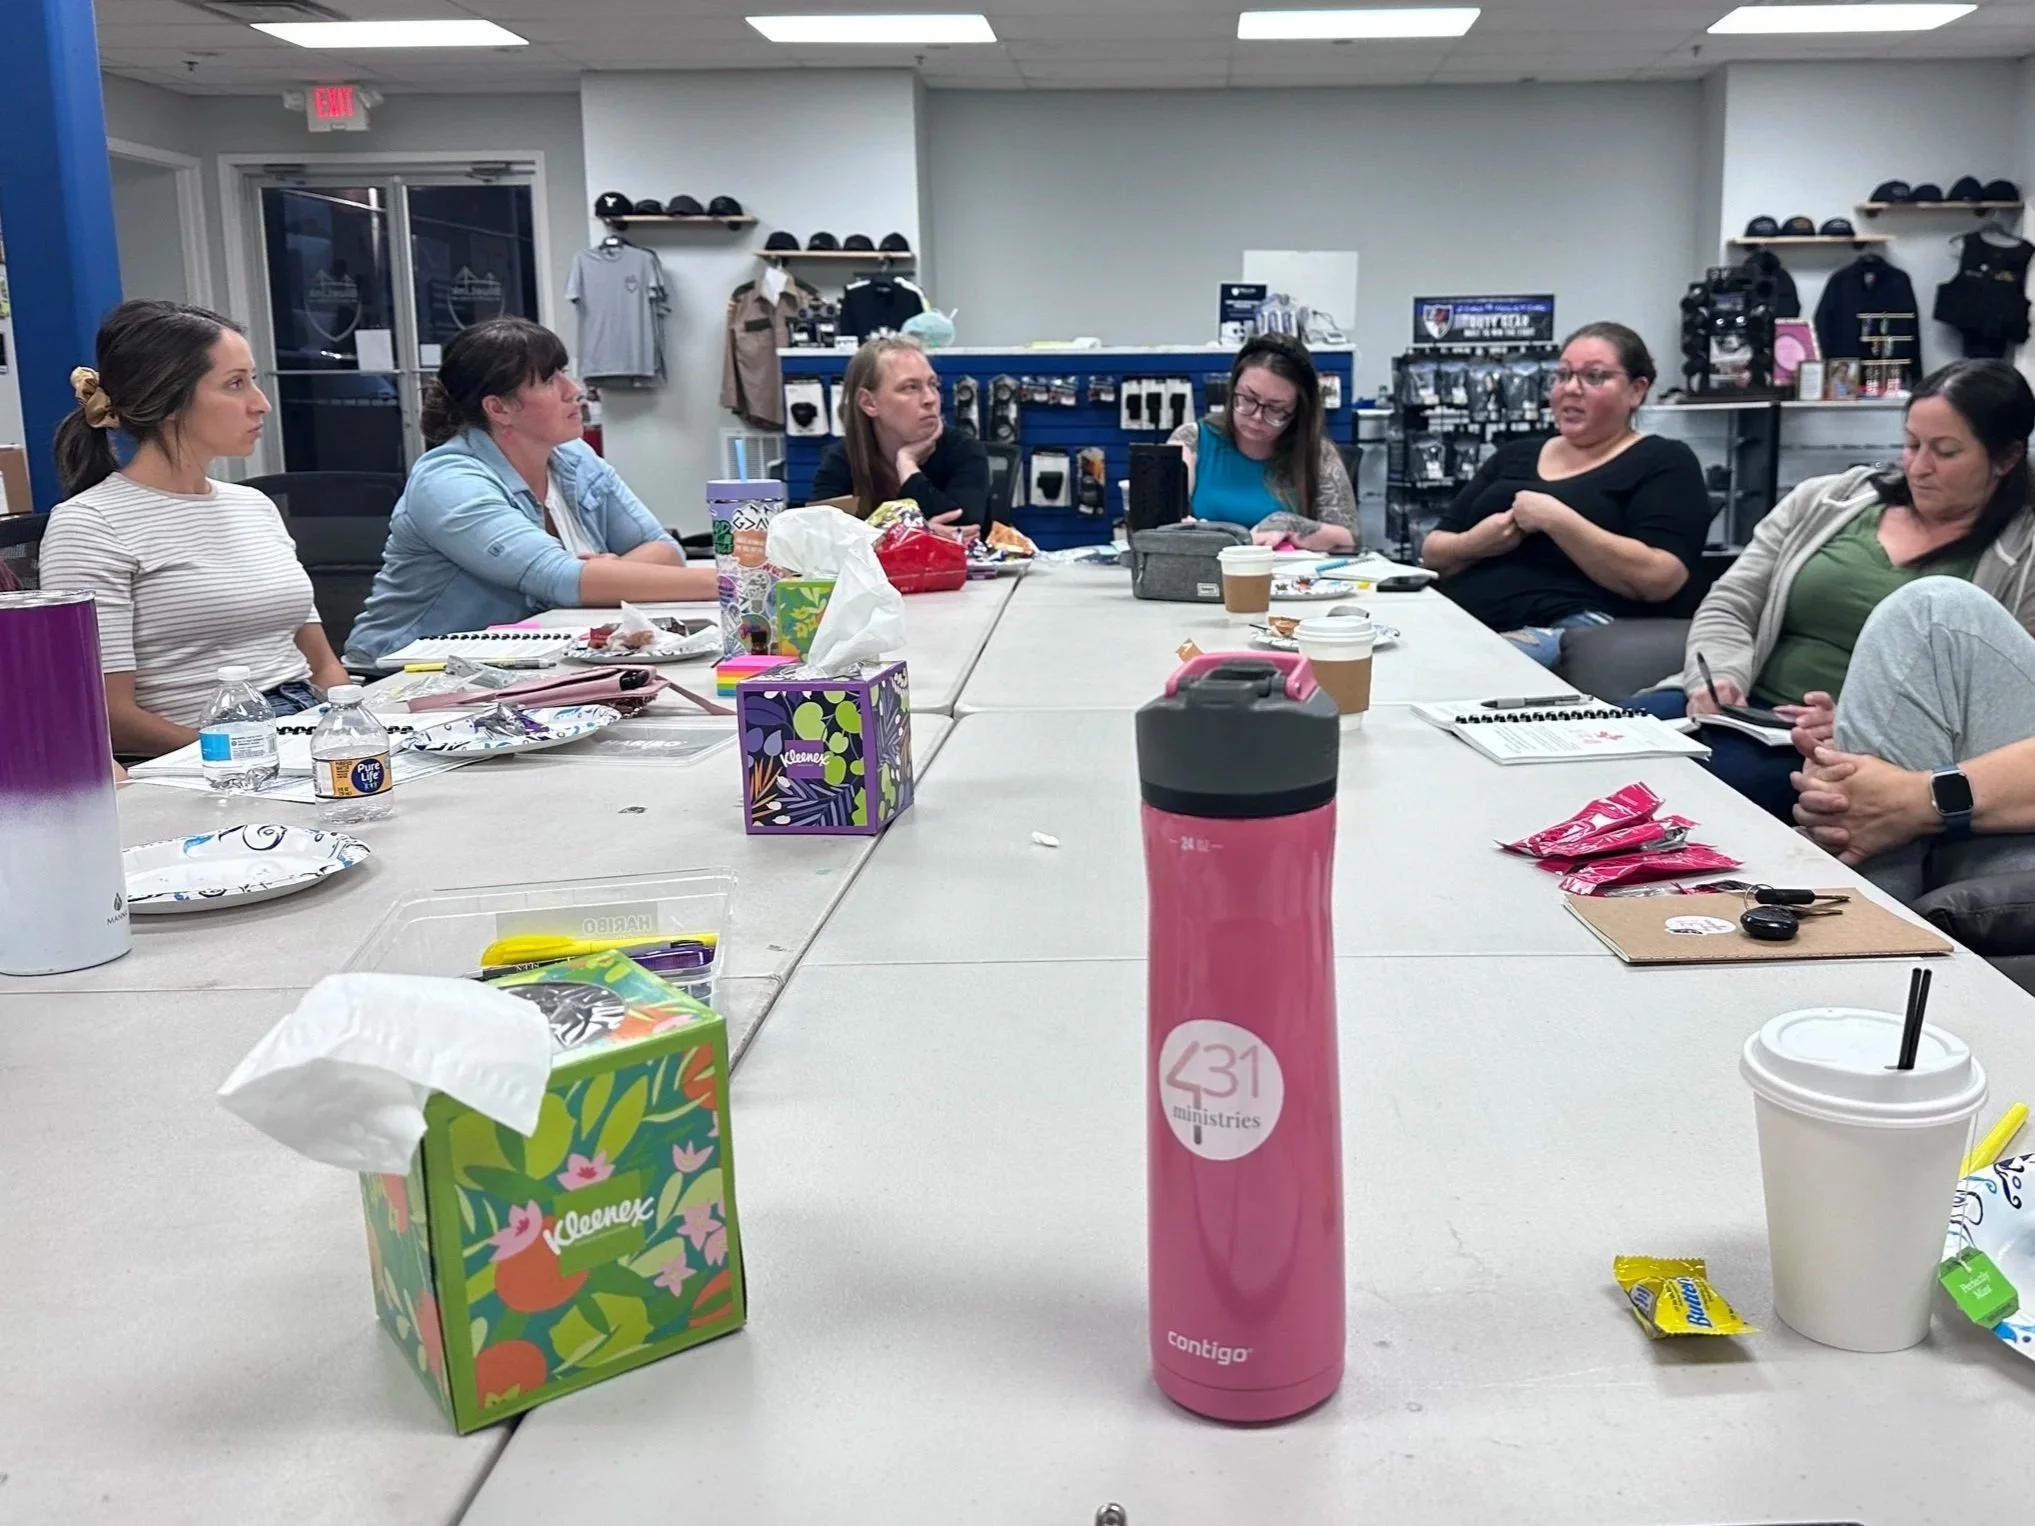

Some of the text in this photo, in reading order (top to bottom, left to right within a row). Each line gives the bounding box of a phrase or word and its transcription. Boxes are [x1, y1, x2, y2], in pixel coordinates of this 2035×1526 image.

[315, 86, 354, 118] EXIT
[357, 762, 380, 774] Pure
[779, 749, 830, 768] Kleenex
[361, 771, 379, 783] Life
[1180, 835, 1195, 852] 24
[1166, 1040, 1260, 1146] 431
[1173, 1104, 1262, 1130] ministries
[542, 1196, 655, 1256] Kleenex
[1959, 1271, 1992, 1294] Perfectly
[1974, 1284, 1993, 1300] Mint
[1167, 1330, 1248, 1366] contigo
